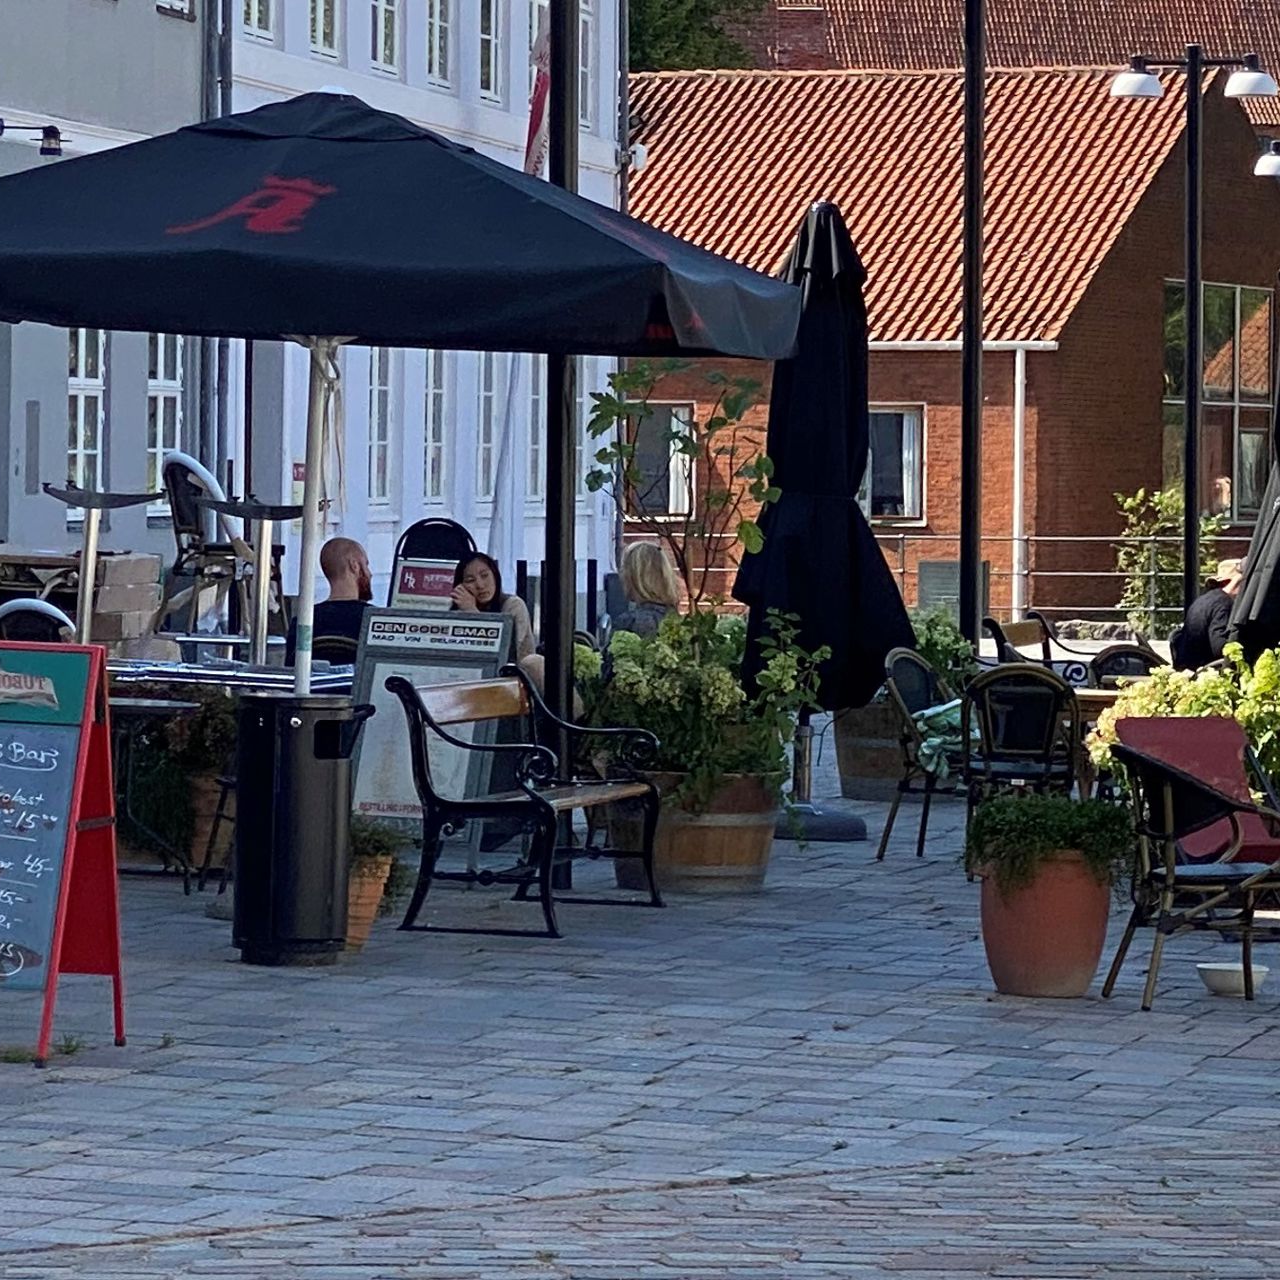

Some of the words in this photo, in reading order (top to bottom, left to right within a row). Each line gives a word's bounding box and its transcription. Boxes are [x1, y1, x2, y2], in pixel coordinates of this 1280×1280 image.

[373, 622, 405, 633] DEN
[409, 624, 451, 635] GODE
[453, 627, 498, 638] SMAG
[372, 634, 395, 642] MAD
[404, 635, 421, 643] VIN
